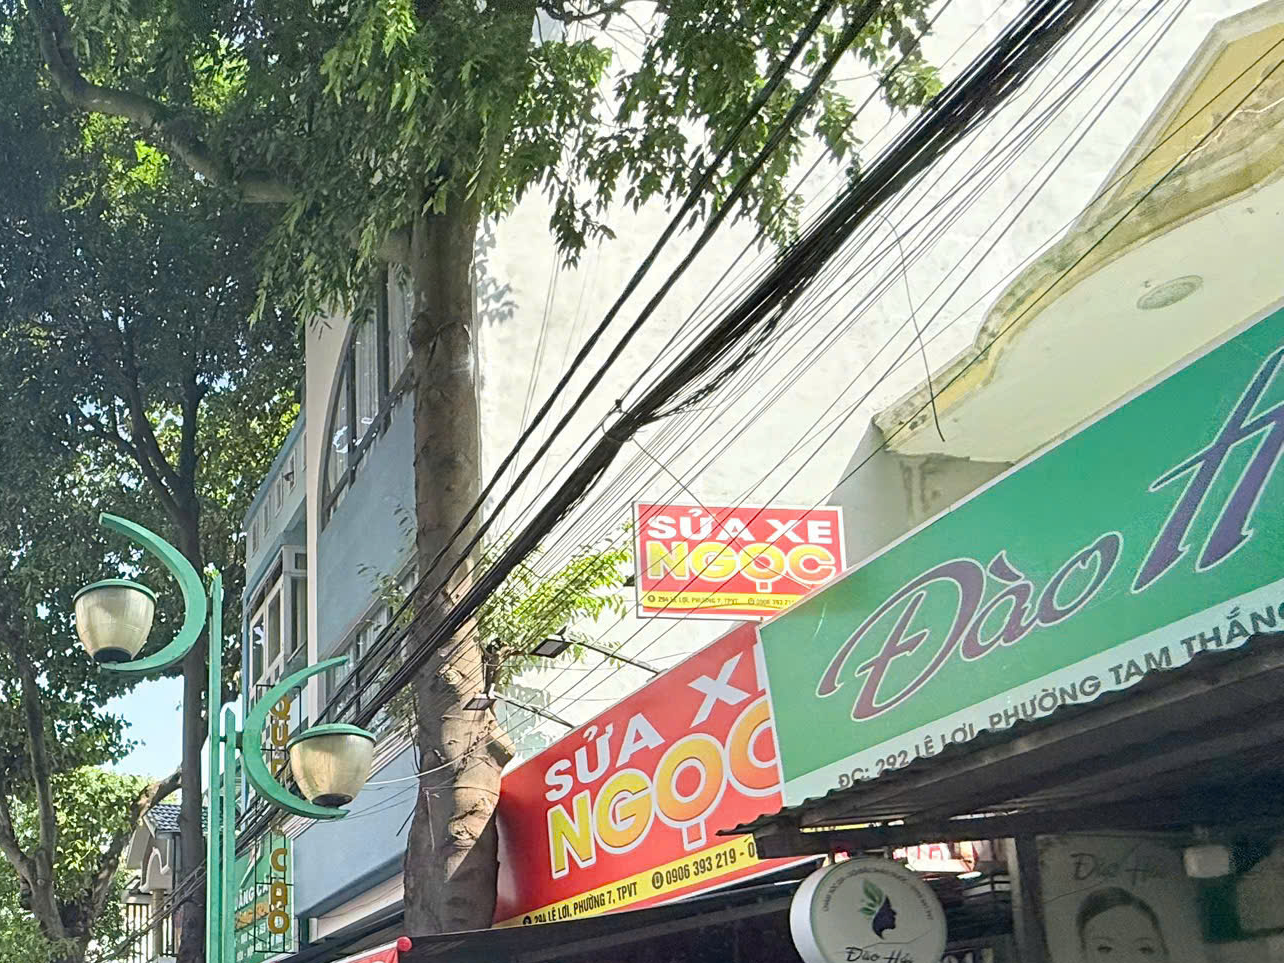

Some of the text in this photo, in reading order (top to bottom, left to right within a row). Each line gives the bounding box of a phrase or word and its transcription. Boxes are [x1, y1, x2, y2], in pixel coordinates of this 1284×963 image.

[647, 508, 833, 544] SỬA XE
[645, 540, 837, 593] NGỌC
[816, 530, 1124, 722] Đào
[988, 675, 1102, 732] PHƯỜNG
[1109, 645, 1173, 687] TAM
[544, 712, 666, 802] SỬA
[573, 893, 606, 916] PHƯỜNG
[616, 881, 638, 902] TPVT
[666, 862, 691, 886] 0906
[692, 854, 713, 878] 393
[715, 846, 737, 869] 219
